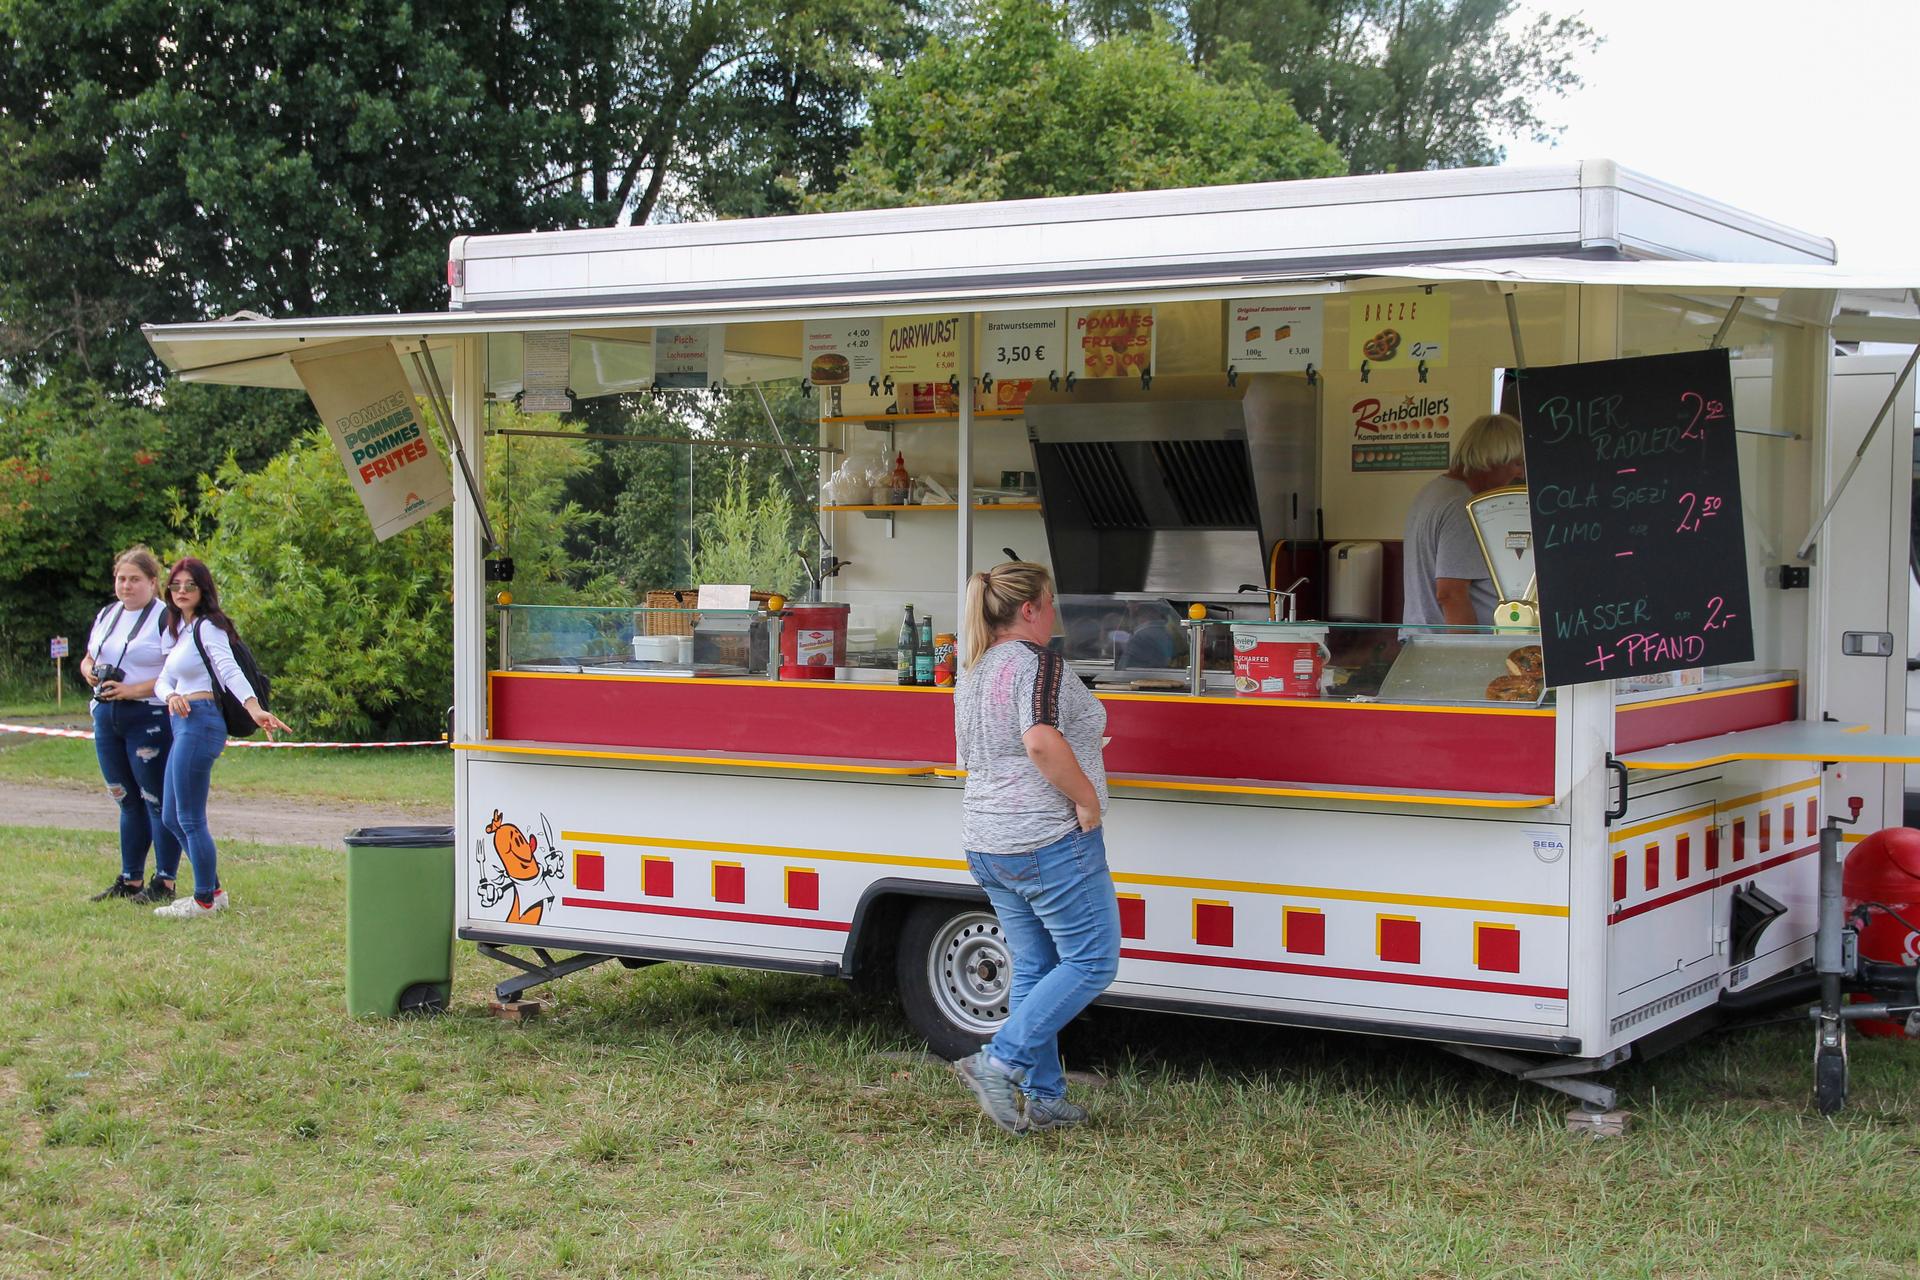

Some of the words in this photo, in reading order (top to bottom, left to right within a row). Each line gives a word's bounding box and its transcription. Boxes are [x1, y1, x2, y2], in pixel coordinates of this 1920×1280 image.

[889, 317, 960, 352] CURRYWURST
[988, 320, 1056, 332] Bratwurstsemmel
[1077, 314, 1154, 330] POMMES
[997, 346, 1031, 364] 3,50
[1035, 345, 1046, 361] €
[1081, 335, 1149, 348] FRITES
[1246, 349, 1262, 357] 100g
[1294, 348, 1310, 356] 3,00
[336, 390, 408, 433] POMMES
[344, 406, 414, 450] POMMES
[1352, 397, 1449, 437] Rothballers
[1539, 395, 1630, 444] BIER
[352, 422, 420, 466] POMMES
[1358, 433, 1393, 441] Kompetenz
[1427, 431, 1432, 439] &
[1434, 431, 1449, 439] food
[1592, 426, 1687, 461] RADLER
[358, 438, 428, 485] FRITES
[1536, 482, 1598, 515] COLA
[1544, 522, 1601, 549] LIMO
[1555, 599, 1651, 639] WASSER
[1616, 633, 1705, 666] PFAND
